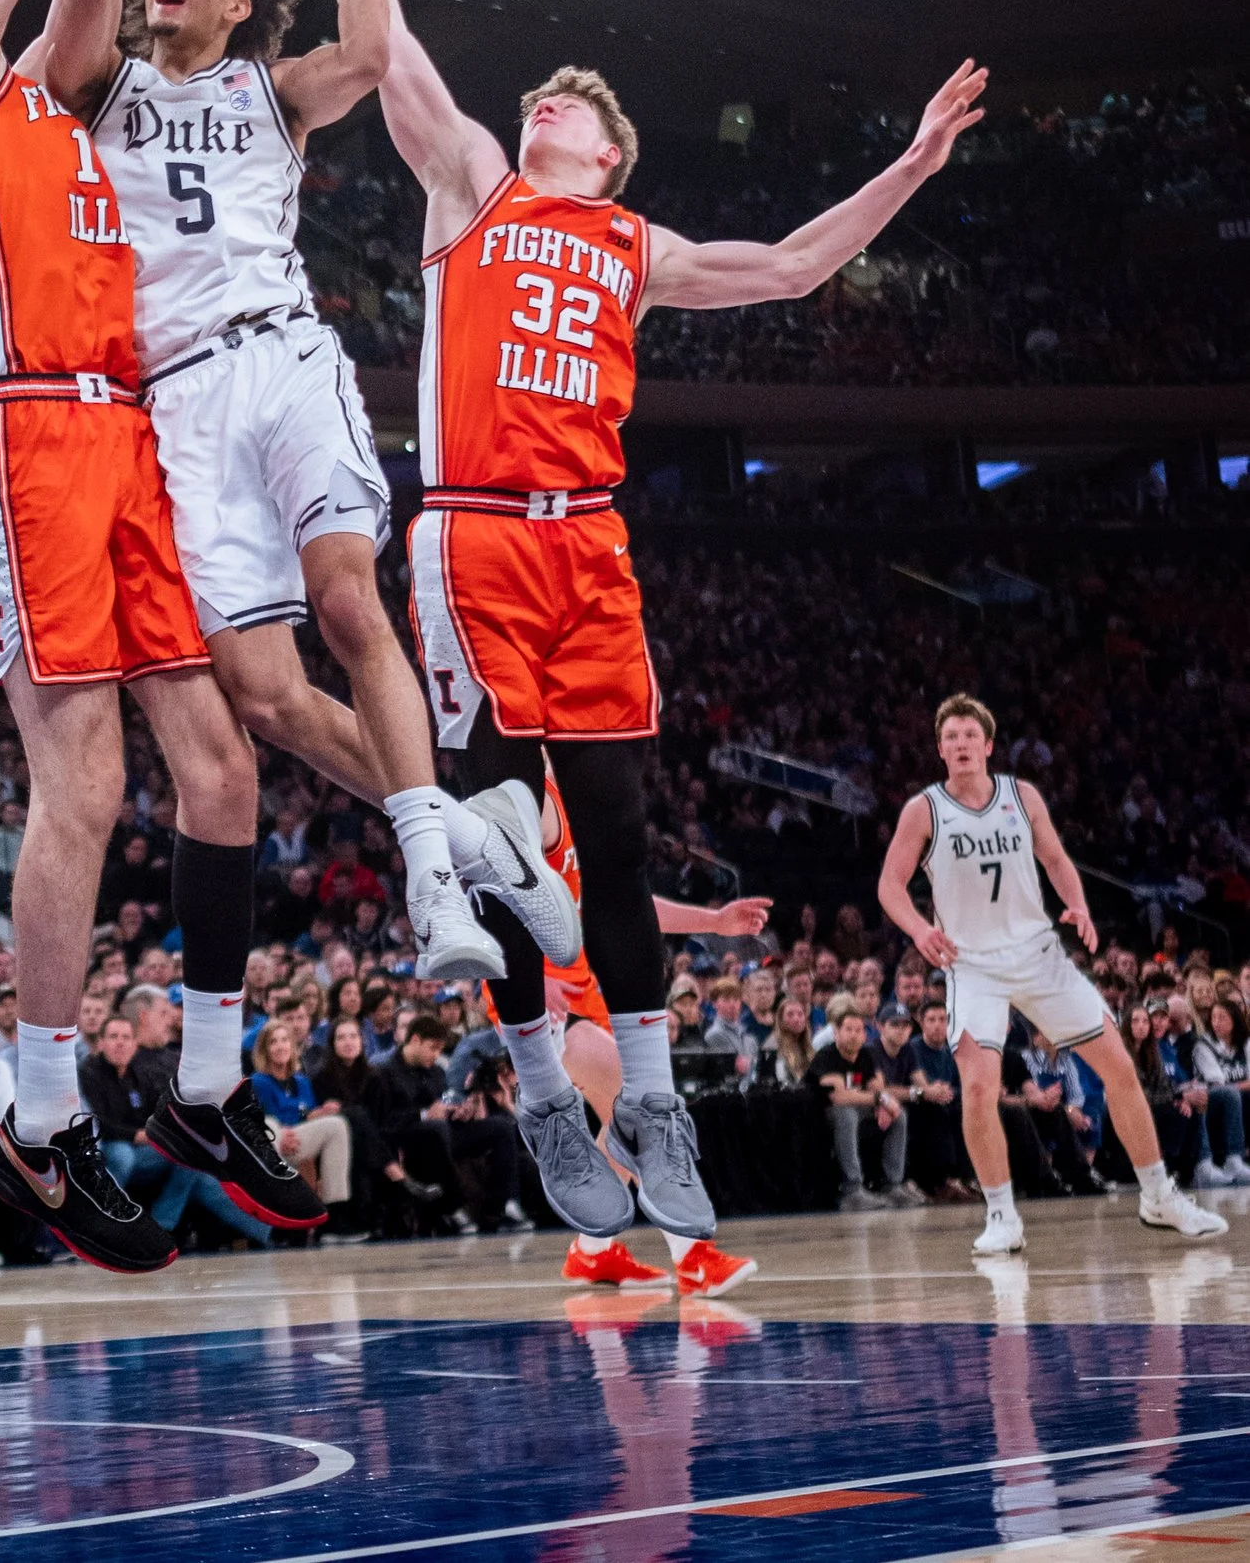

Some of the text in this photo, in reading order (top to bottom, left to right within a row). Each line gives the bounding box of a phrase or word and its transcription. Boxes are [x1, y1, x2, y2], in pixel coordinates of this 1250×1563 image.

[20, 85, 72, 123] FI
[123, 98, 254, 155] Duke
[68, 192, 130, 246] ILL
[164, 162, 215, 236] 5
[478, 223, 638, 314] FIGHTING
[510, 272, 601, 349] 32
[495, 341, 599, 407] ILLINI
[432, 668, 462, 715] I
[948, 829, 1021, 860] Duke
[980, 861, 1003, 904] 7
